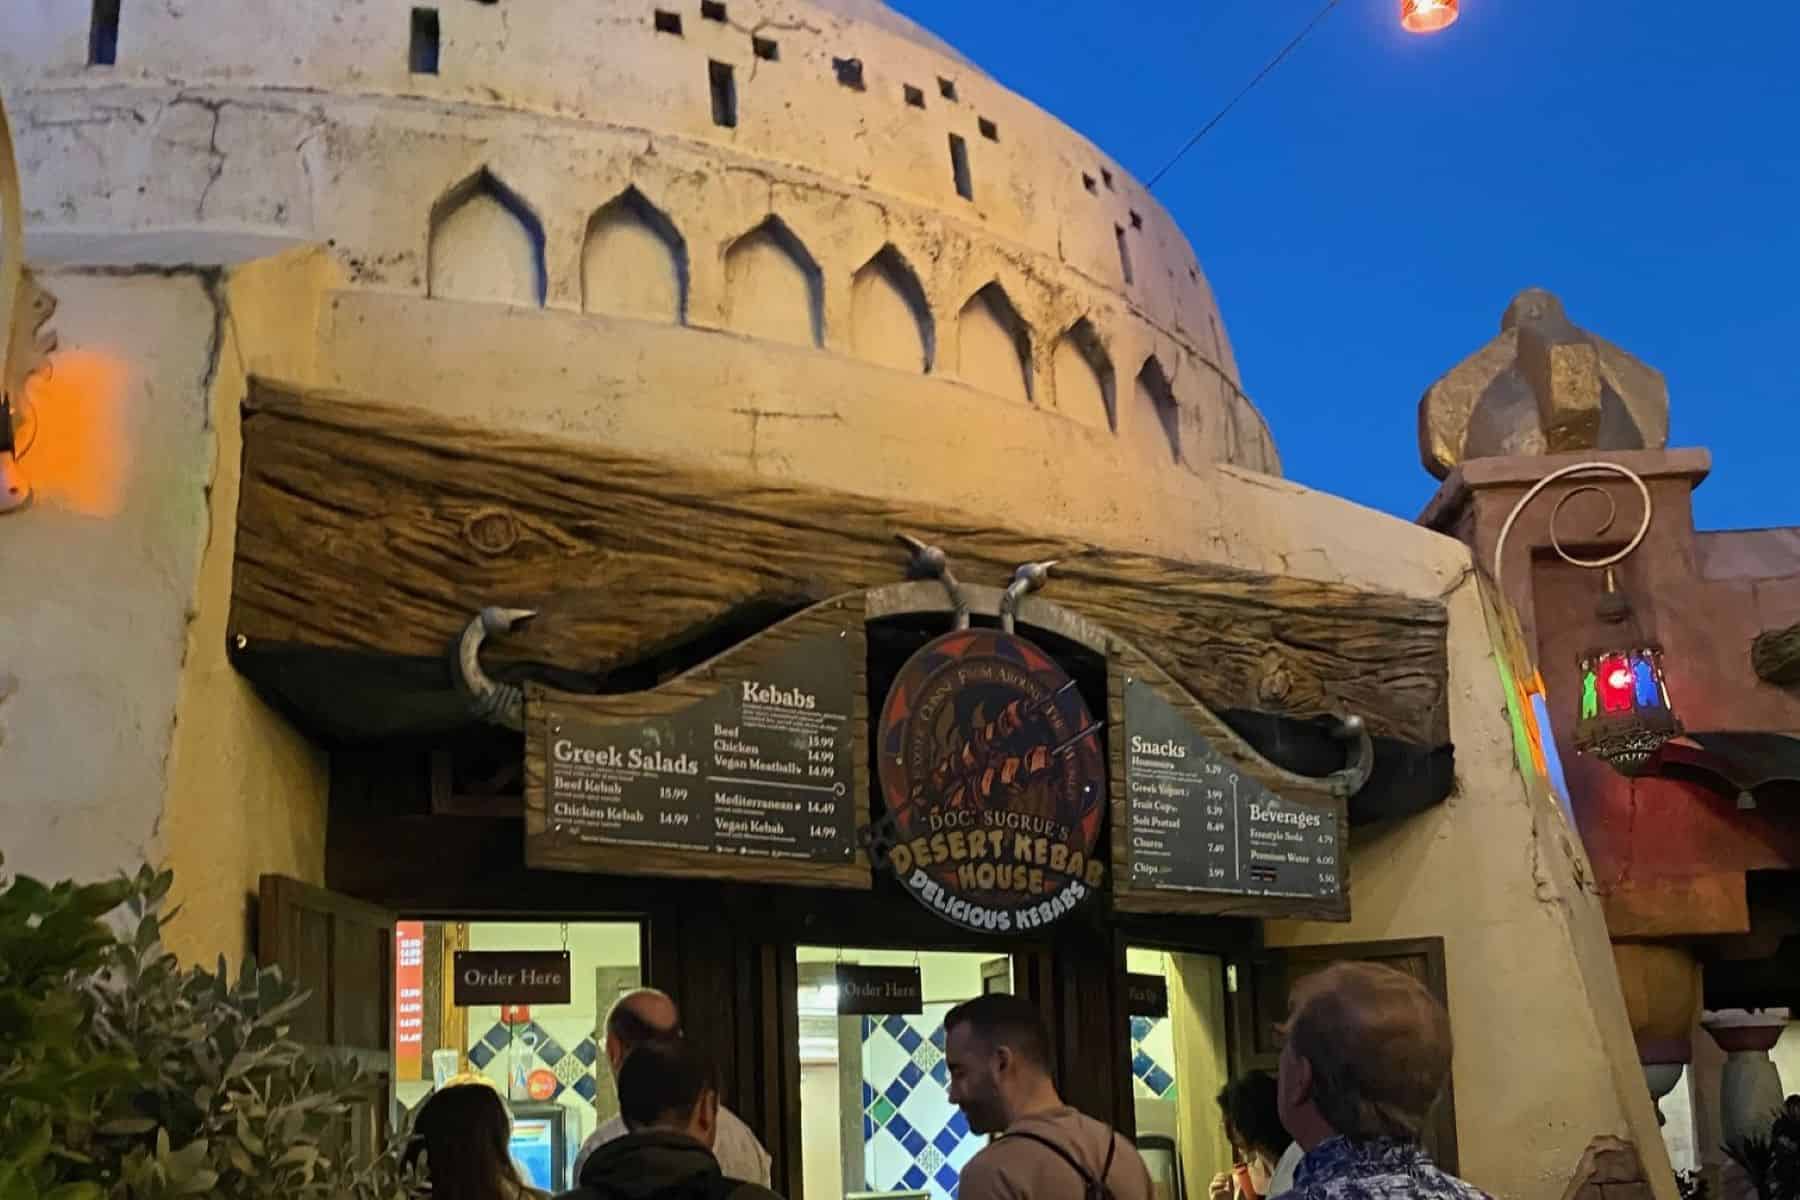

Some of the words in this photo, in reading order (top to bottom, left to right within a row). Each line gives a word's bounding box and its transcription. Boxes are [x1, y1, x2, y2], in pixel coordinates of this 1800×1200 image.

[742, 680, 816, 709] Kebabs
[714, 723, 739, 738] Beef
[808, 735, 834, 748] 15.99
[1131, 735, 1185, 758] Snacks
[554, 739, 622, 767] Greek
[627, 748, 699, 775] Salads
[713, 739, 759, 754] Chicken
[808, 750, 834, 763] 14.99
[714, 753, 747, 770] Vegan
[808, 764, 835, 777] 14.99
[554, 776, 582, 791] Beef
[585, 779, 622, 794] Kebab
[659, 786, 688, 800] 15.99
[1132, 782, 1157, 793] Greek
[554, 802, 604, 818] Chicken
[607, 807, 644, 822] Kebab
[659, 811, 689, 825] 14.99
[714, 792, 793, 811] Mediterranean
[714, 816, 748, 835] Vegan
[750, 819, 784, 834] Kebab
[810, 824, 836, 838] 14.99
[930, 810, 971, 831] DOC
[983, 810, 1069, 841] SUGRUE'S
[1250, 804, 1320, 829] Beverages
[889, 829, 1004, 875] DESERT
[1013, 833, 1104, 888] KEBAB
[1134, 862, 1158, 876] Chips
[957, 862, 1045, 894] HOUSE
[909, 868, 1012, 931] DELICIOUS
[1016, 880, 1087, 930] KEBABS
[464, 969, 513, 986] Order
[520, 969, 562, 986] Here
[844, 980, 880, 997] Order
